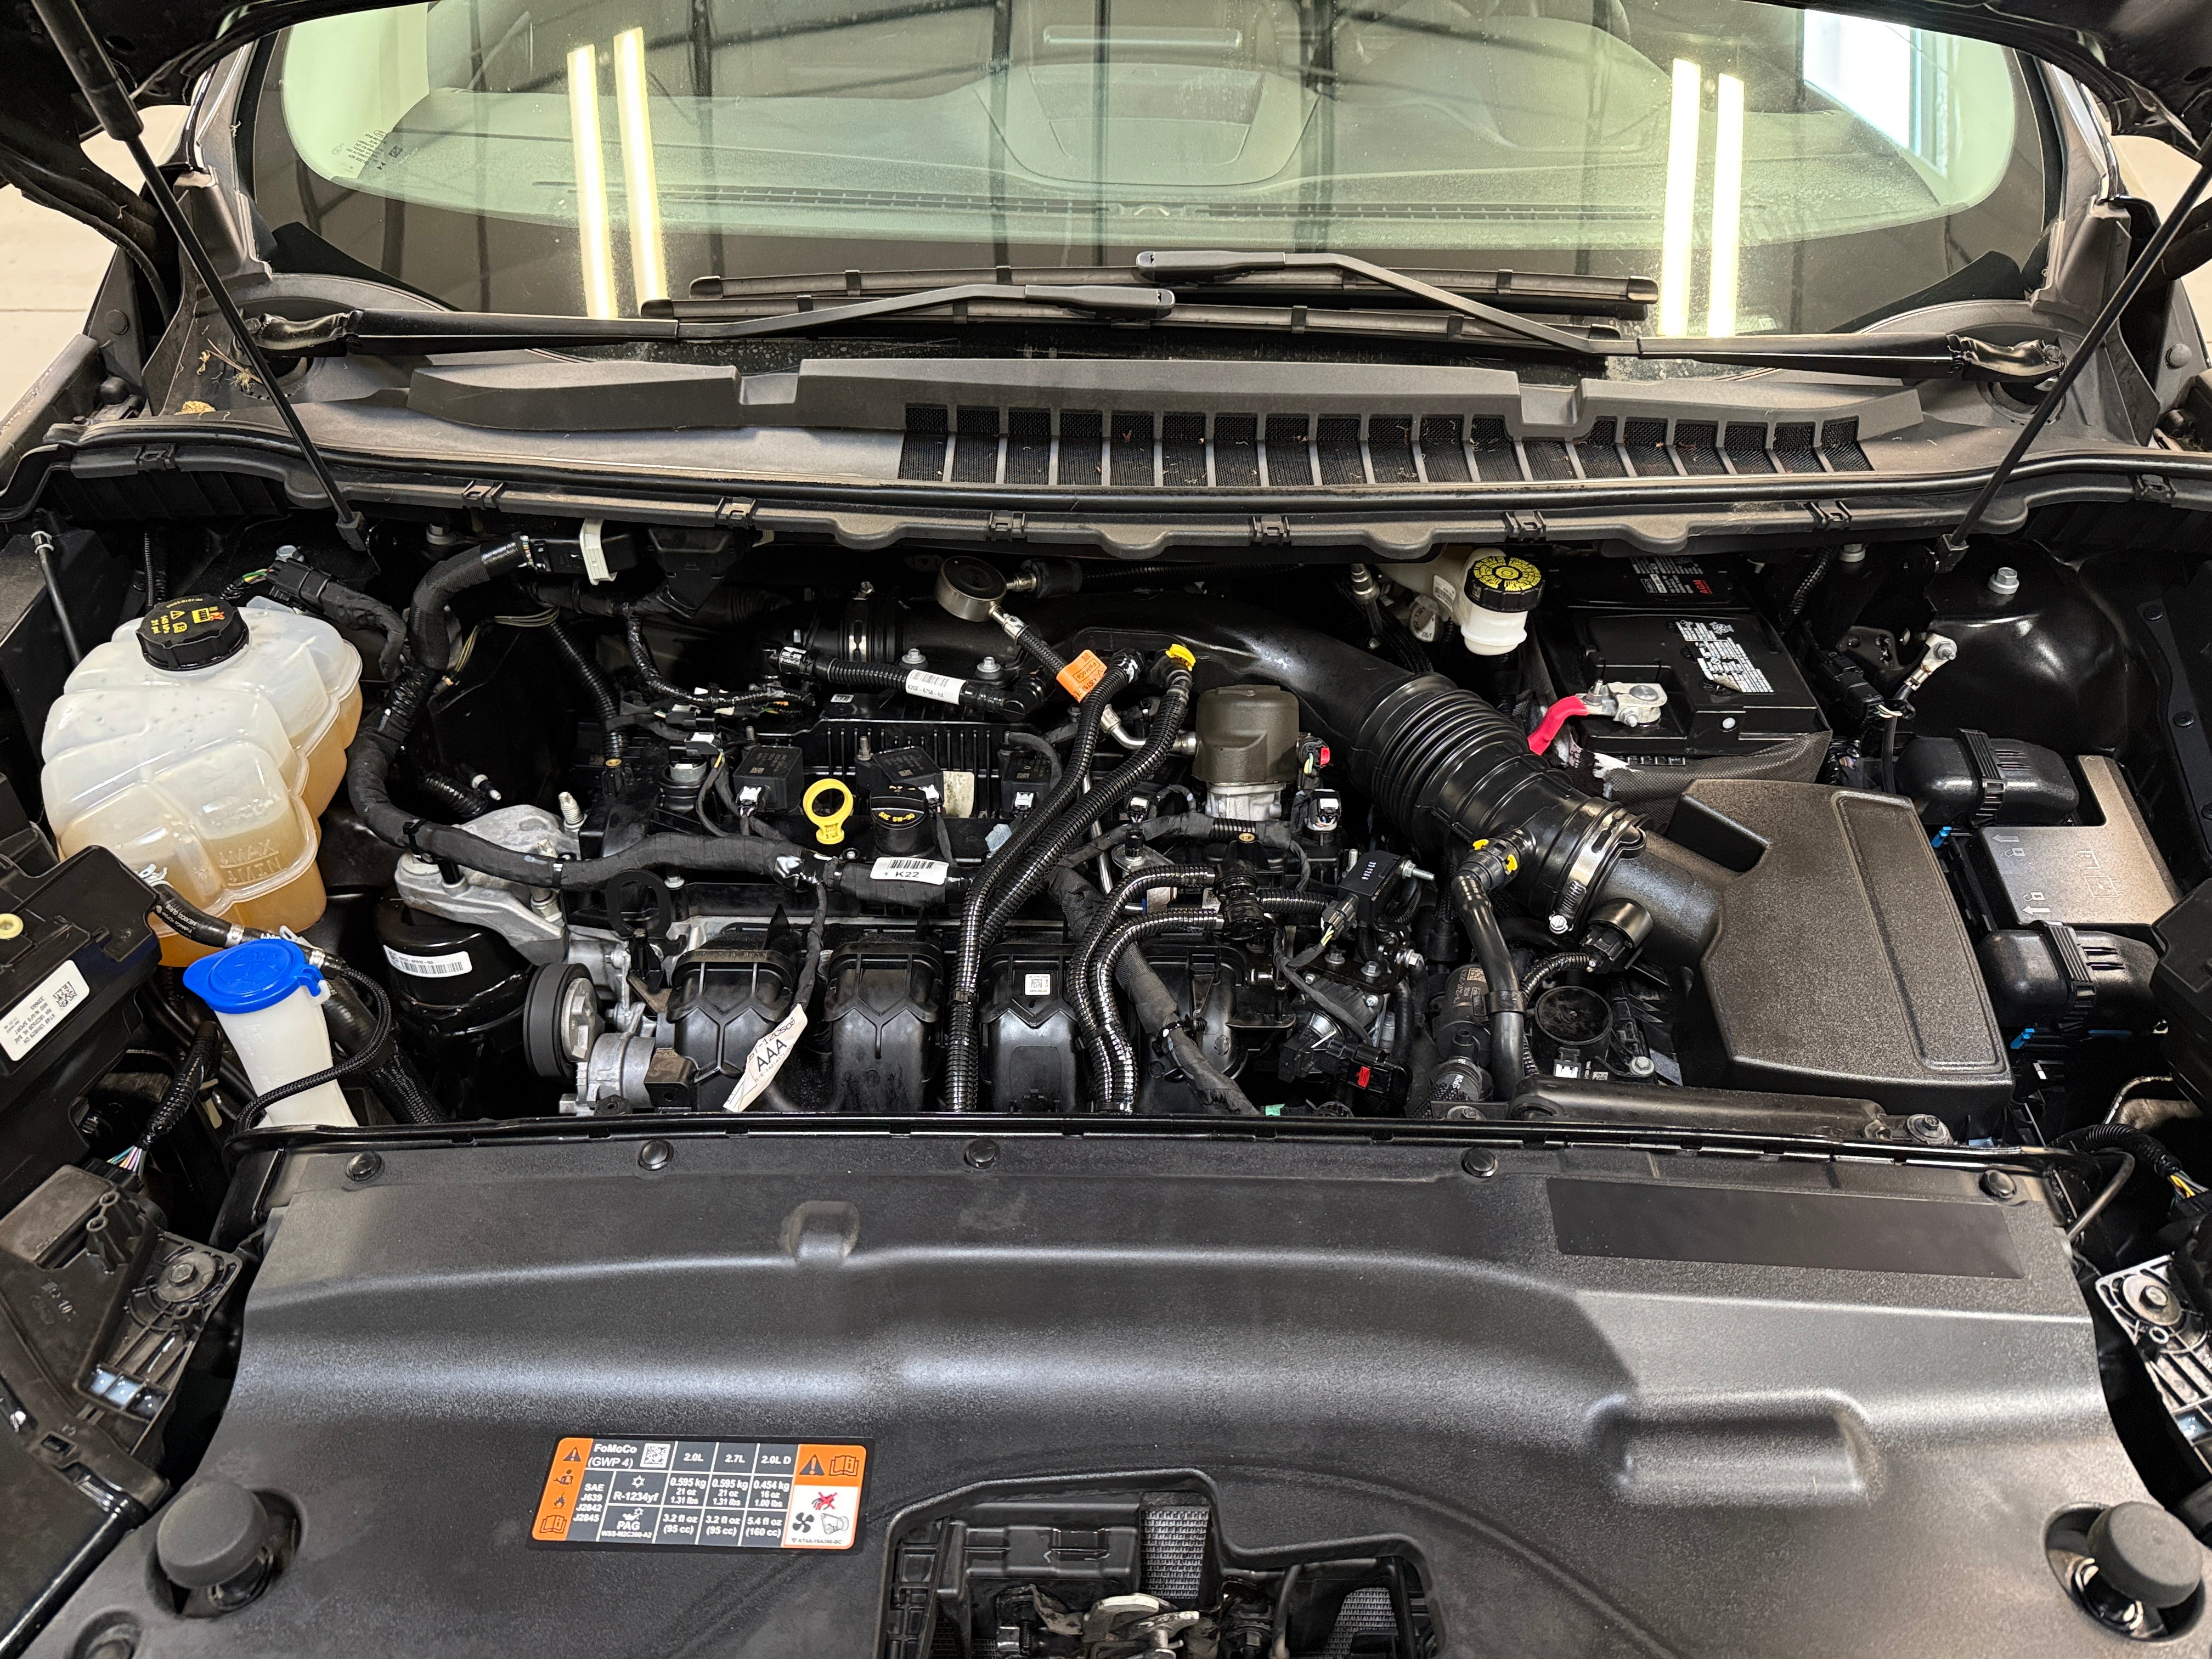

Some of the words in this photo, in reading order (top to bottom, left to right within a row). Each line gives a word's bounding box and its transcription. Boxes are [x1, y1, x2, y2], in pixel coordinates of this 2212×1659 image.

[1692, 580, 1709, 594] AGM
[1077, 662, 1097, 679] FoMoCo
[878, 811, 891, 821] SAE
[892, 813, 915, 822] 5W-30
[229, 839, 275, 864] MAX
[237, 857, 283, 882] MIN
[757, 1039, 787, 1072] AAA
[594, 1443, 637, 1454] FoMoCo
[588, 1457, 620, 1468] (GWP
[621, 1458, 634, 1469] 4)
[683, 1453, 704, 1462] 2.0L
[724, 1454, 746, 1463] 2.7L
[761, 1455, 782, 1464] 2.0L
[783, 1455, 792, 1465] D
[584, 1483, 605, 1492] SAE
[670, 1477, 694, 1487] 0.595
[694, 1478, 707, 1489] kg
[712, 1479, 736, 1488] 0.595
[736, 1480, 749, 1491] kg
[753, 1480, 777, 1489] 0.454
[777, 1481, 790, 1492] kg
[675, 1487, 686, 1496] 21
[718, 1489, 728, 1497] 21
[580, 1493, 603, 1502] J639
[613, 1491, 659, 1504] R-1234yf
[686, 1497, 699, 1505] lbs
[729, 1498, 741, 1506] lbs
[576, 1504, 602, 1512] J2842
[770, 1499, 783, 1508] lbs
[573, 1514, 600, 1522] J2845
[662, 1514, 678, 1522] 3.2
[678, 1514, 685, 1523] fl
[705, 1515, 720, 1524] 3.2
[720, 1516, 728, 1525] fl
[747, 1517, 761, 1525] 5.4
[762, 1517, 770, 1526] fl
[616, 1520, 641, 1531] PAG
[663, 1524, 679, 1534] (95
[679, 1525, 695, 1535] cc)
[706, 1526, 721, 1536] (95
[722, 1527, 737, 1537] cc)
[746, 1527, 766, 1537] (160
[766, 1529, 782, 1538] cc)
